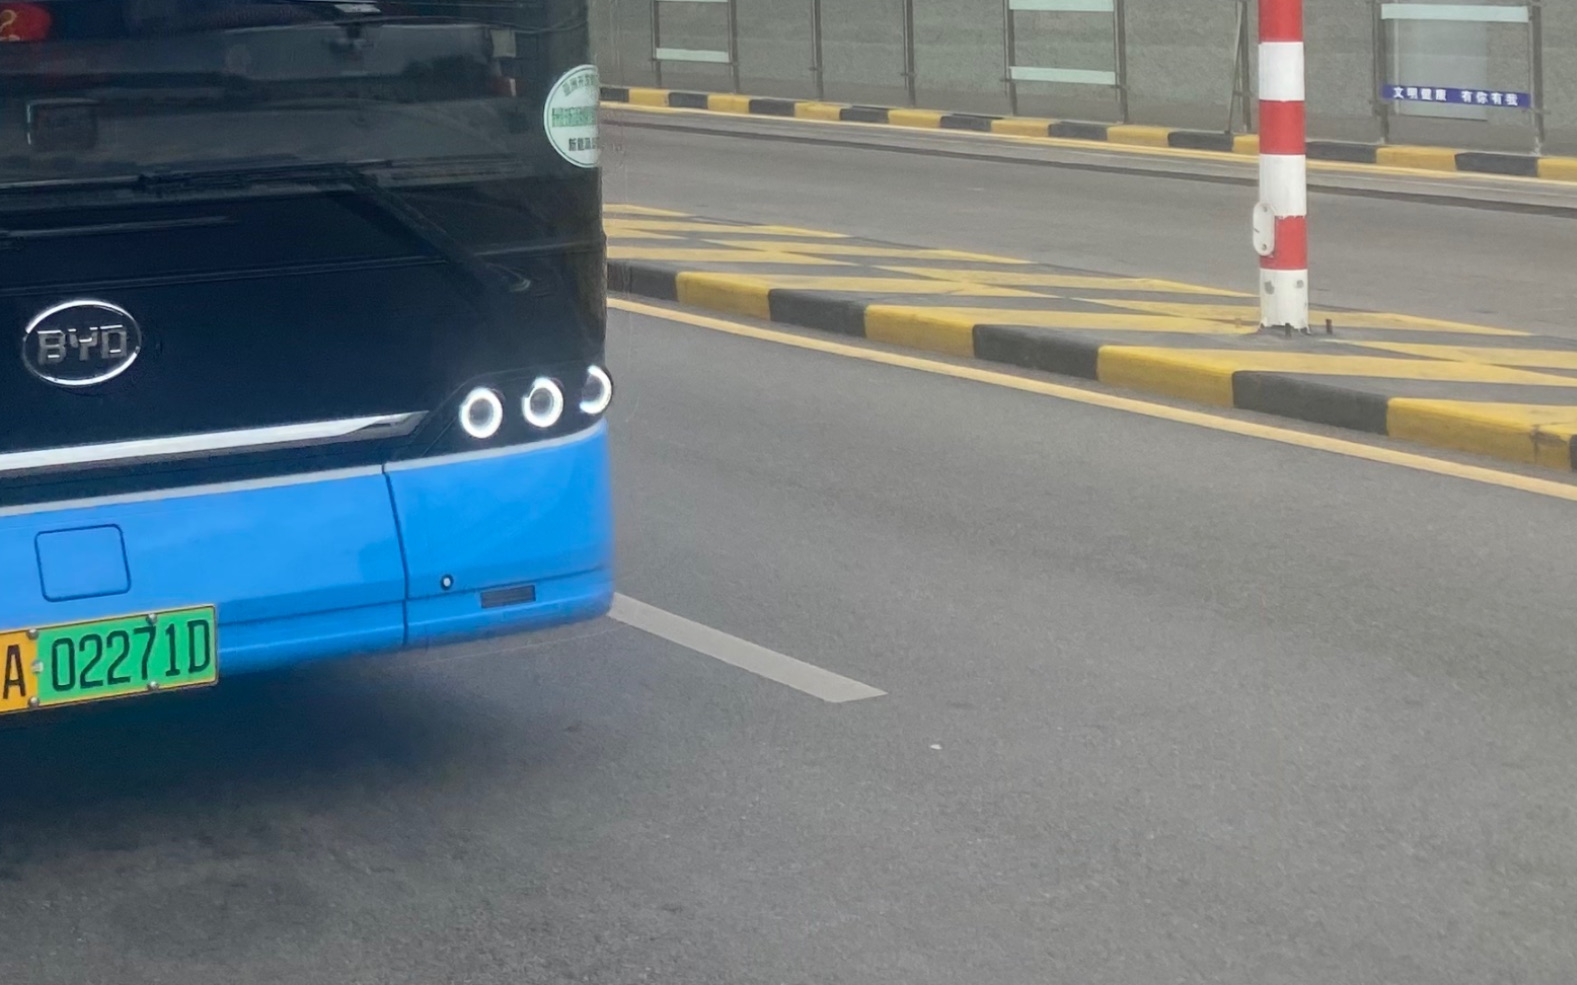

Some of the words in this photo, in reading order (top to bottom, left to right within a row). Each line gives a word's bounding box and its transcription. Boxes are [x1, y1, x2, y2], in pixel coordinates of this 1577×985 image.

[1392, 86, 1447, 102] 文明健康
[1460, 90, 1519, 106] 有你有我
[36, 324, 127, 365] BYD
[50, 618, 212, 693] 02271D
